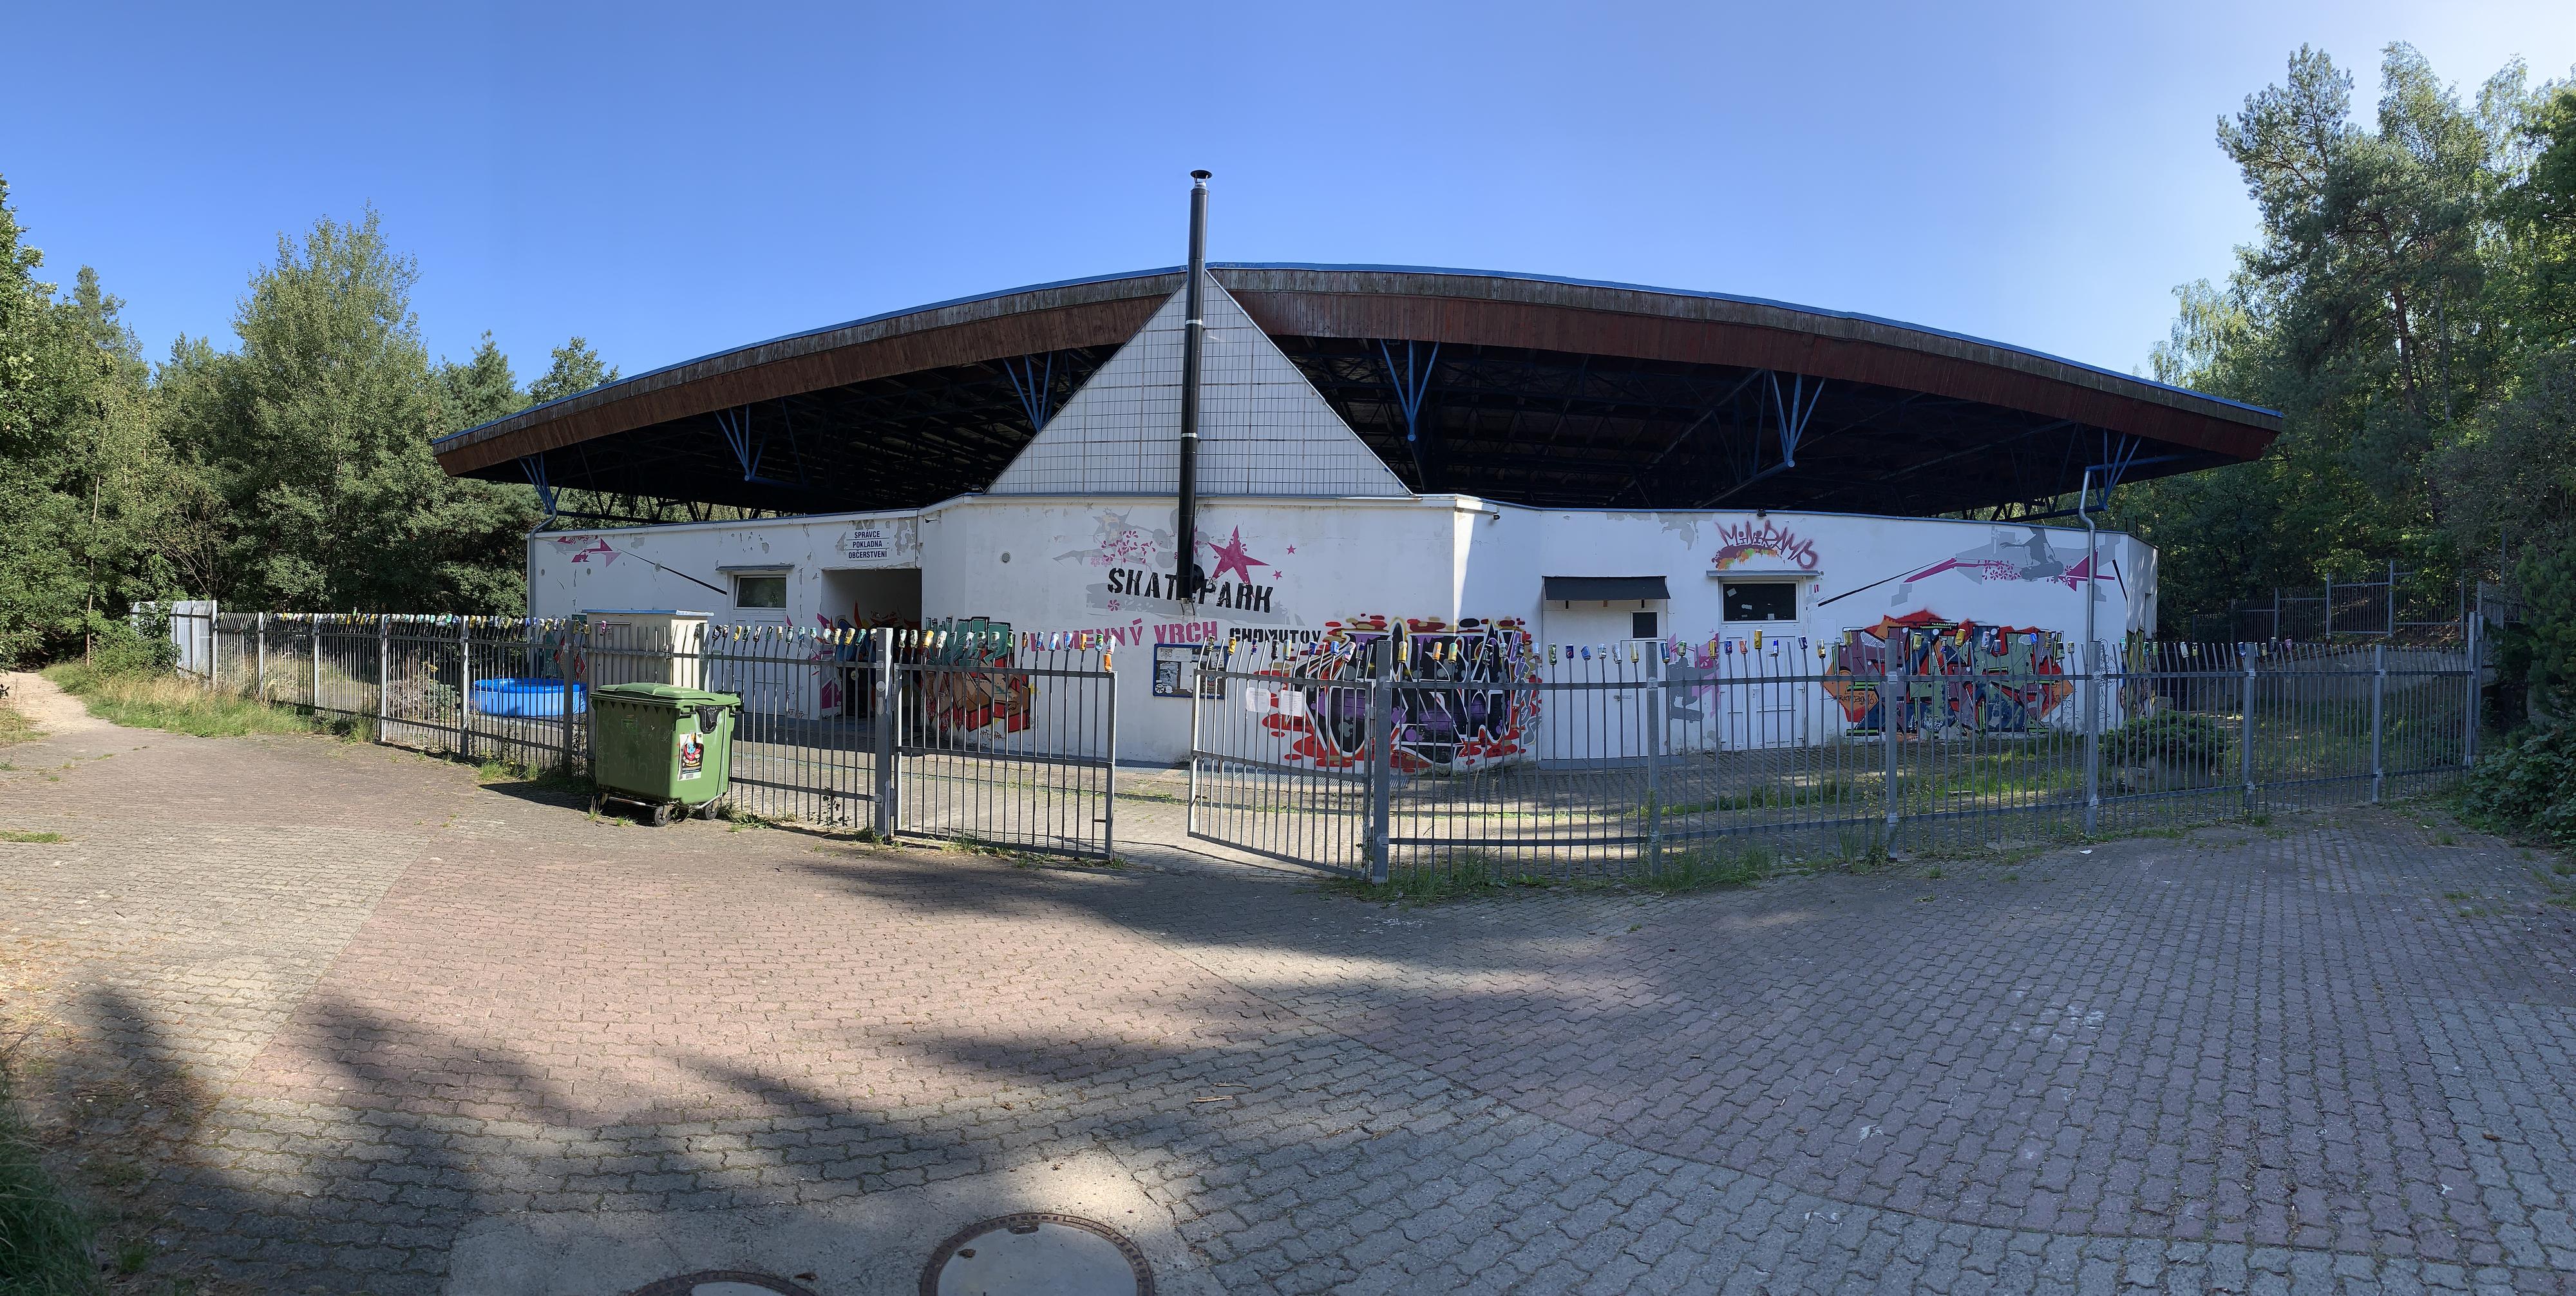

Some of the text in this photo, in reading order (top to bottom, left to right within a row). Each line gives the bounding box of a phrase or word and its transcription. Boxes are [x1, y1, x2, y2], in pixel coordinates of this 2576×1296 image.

[854, 529, 880, 538] SPRÁVCE
[852, 540, 882, 549] POKLADNA
[848, 549, 887, 559] OBČERSTVENÍ
[1107, 567, 1274, 613] SKATPARK
[1153, 621, 1218, 644] VRCH
[1229, 627, 1321, 644] CHOMUTOV
